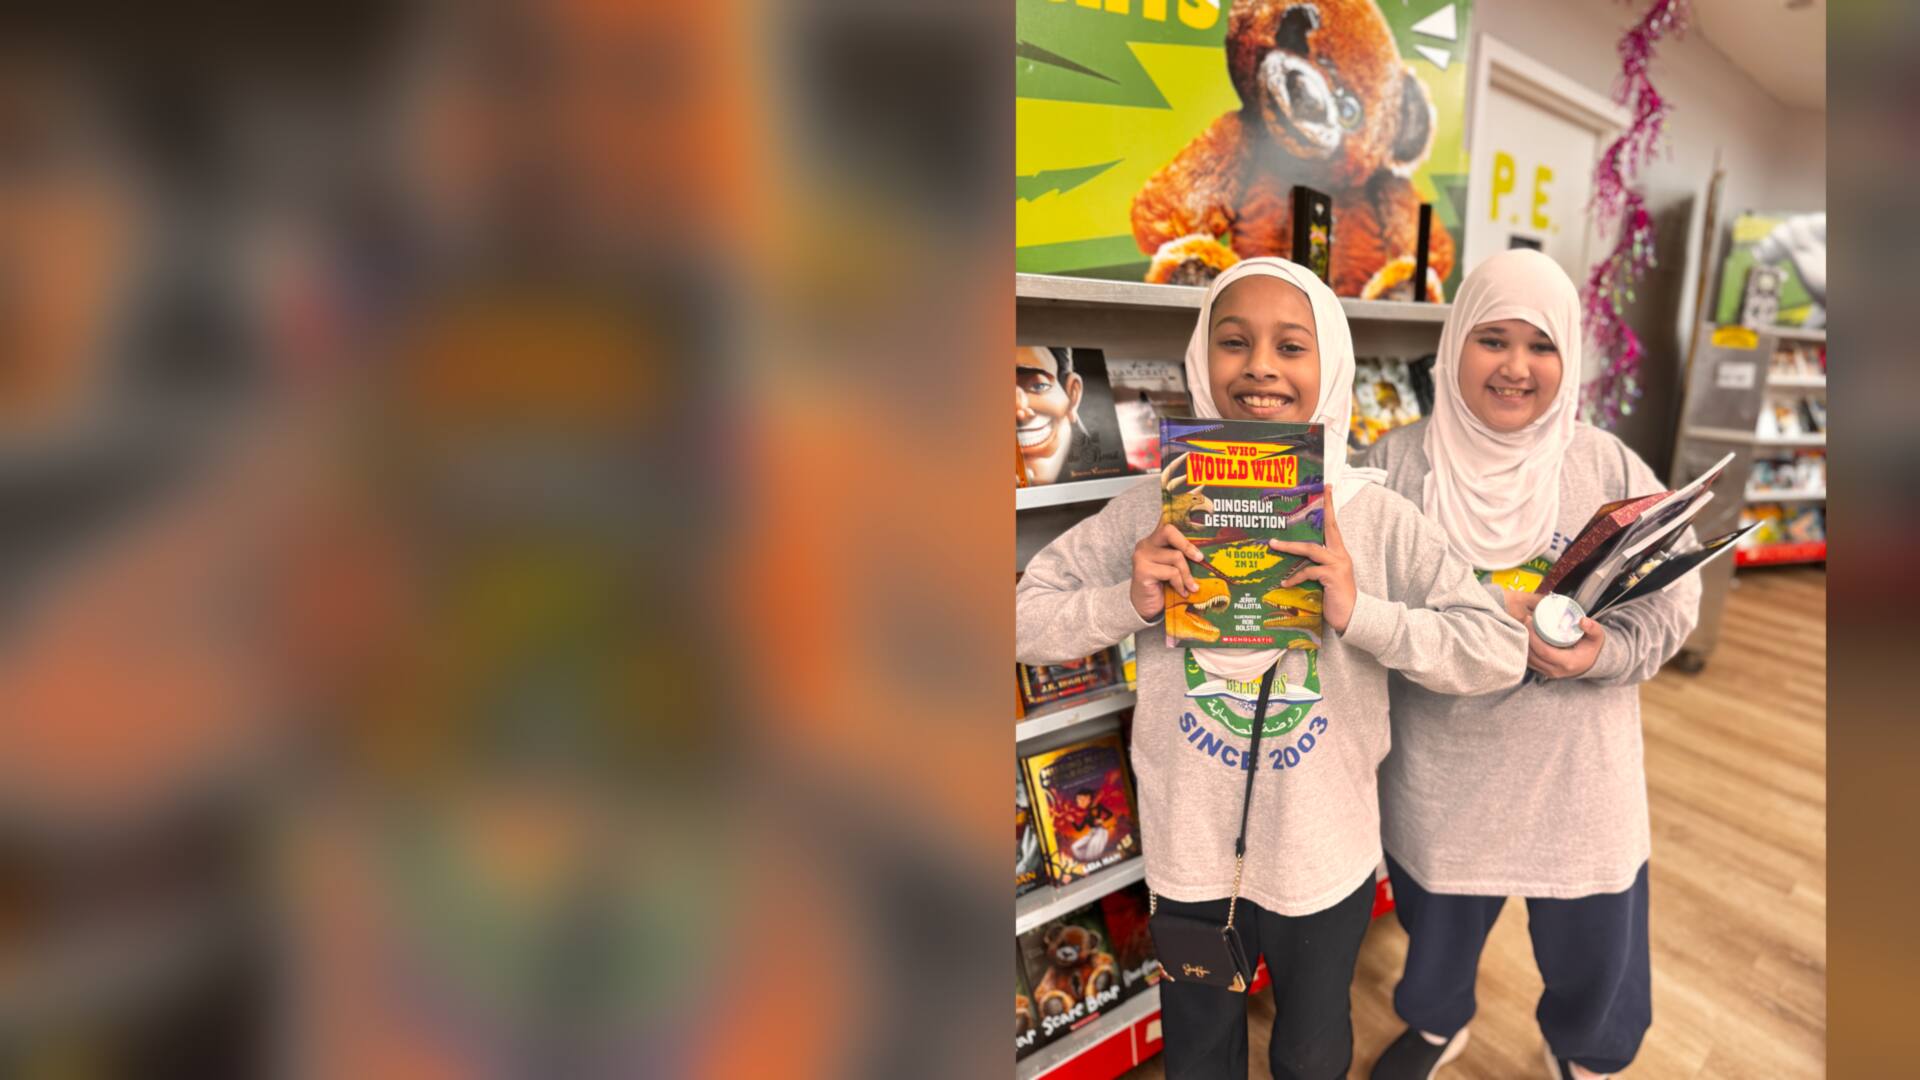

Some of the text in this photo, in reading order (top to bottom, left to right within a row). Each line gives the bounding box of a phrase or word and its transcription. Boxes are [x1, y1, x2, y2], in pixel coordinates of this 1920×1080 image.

[1227, 446, 1257, 457] WHO
[1189, 452, 1295, 485] WOULD WIN?
[1213, 499, 1273, 513] DINOSAUR
[1204, 514, 1286, 529] DESTRUCTION
[1225, 551, 1266, 559] 4 BOOKS
[1226, 673, 1288, 695] BELIERS
[1179, 711, 1328, 771] SINCE 2003
